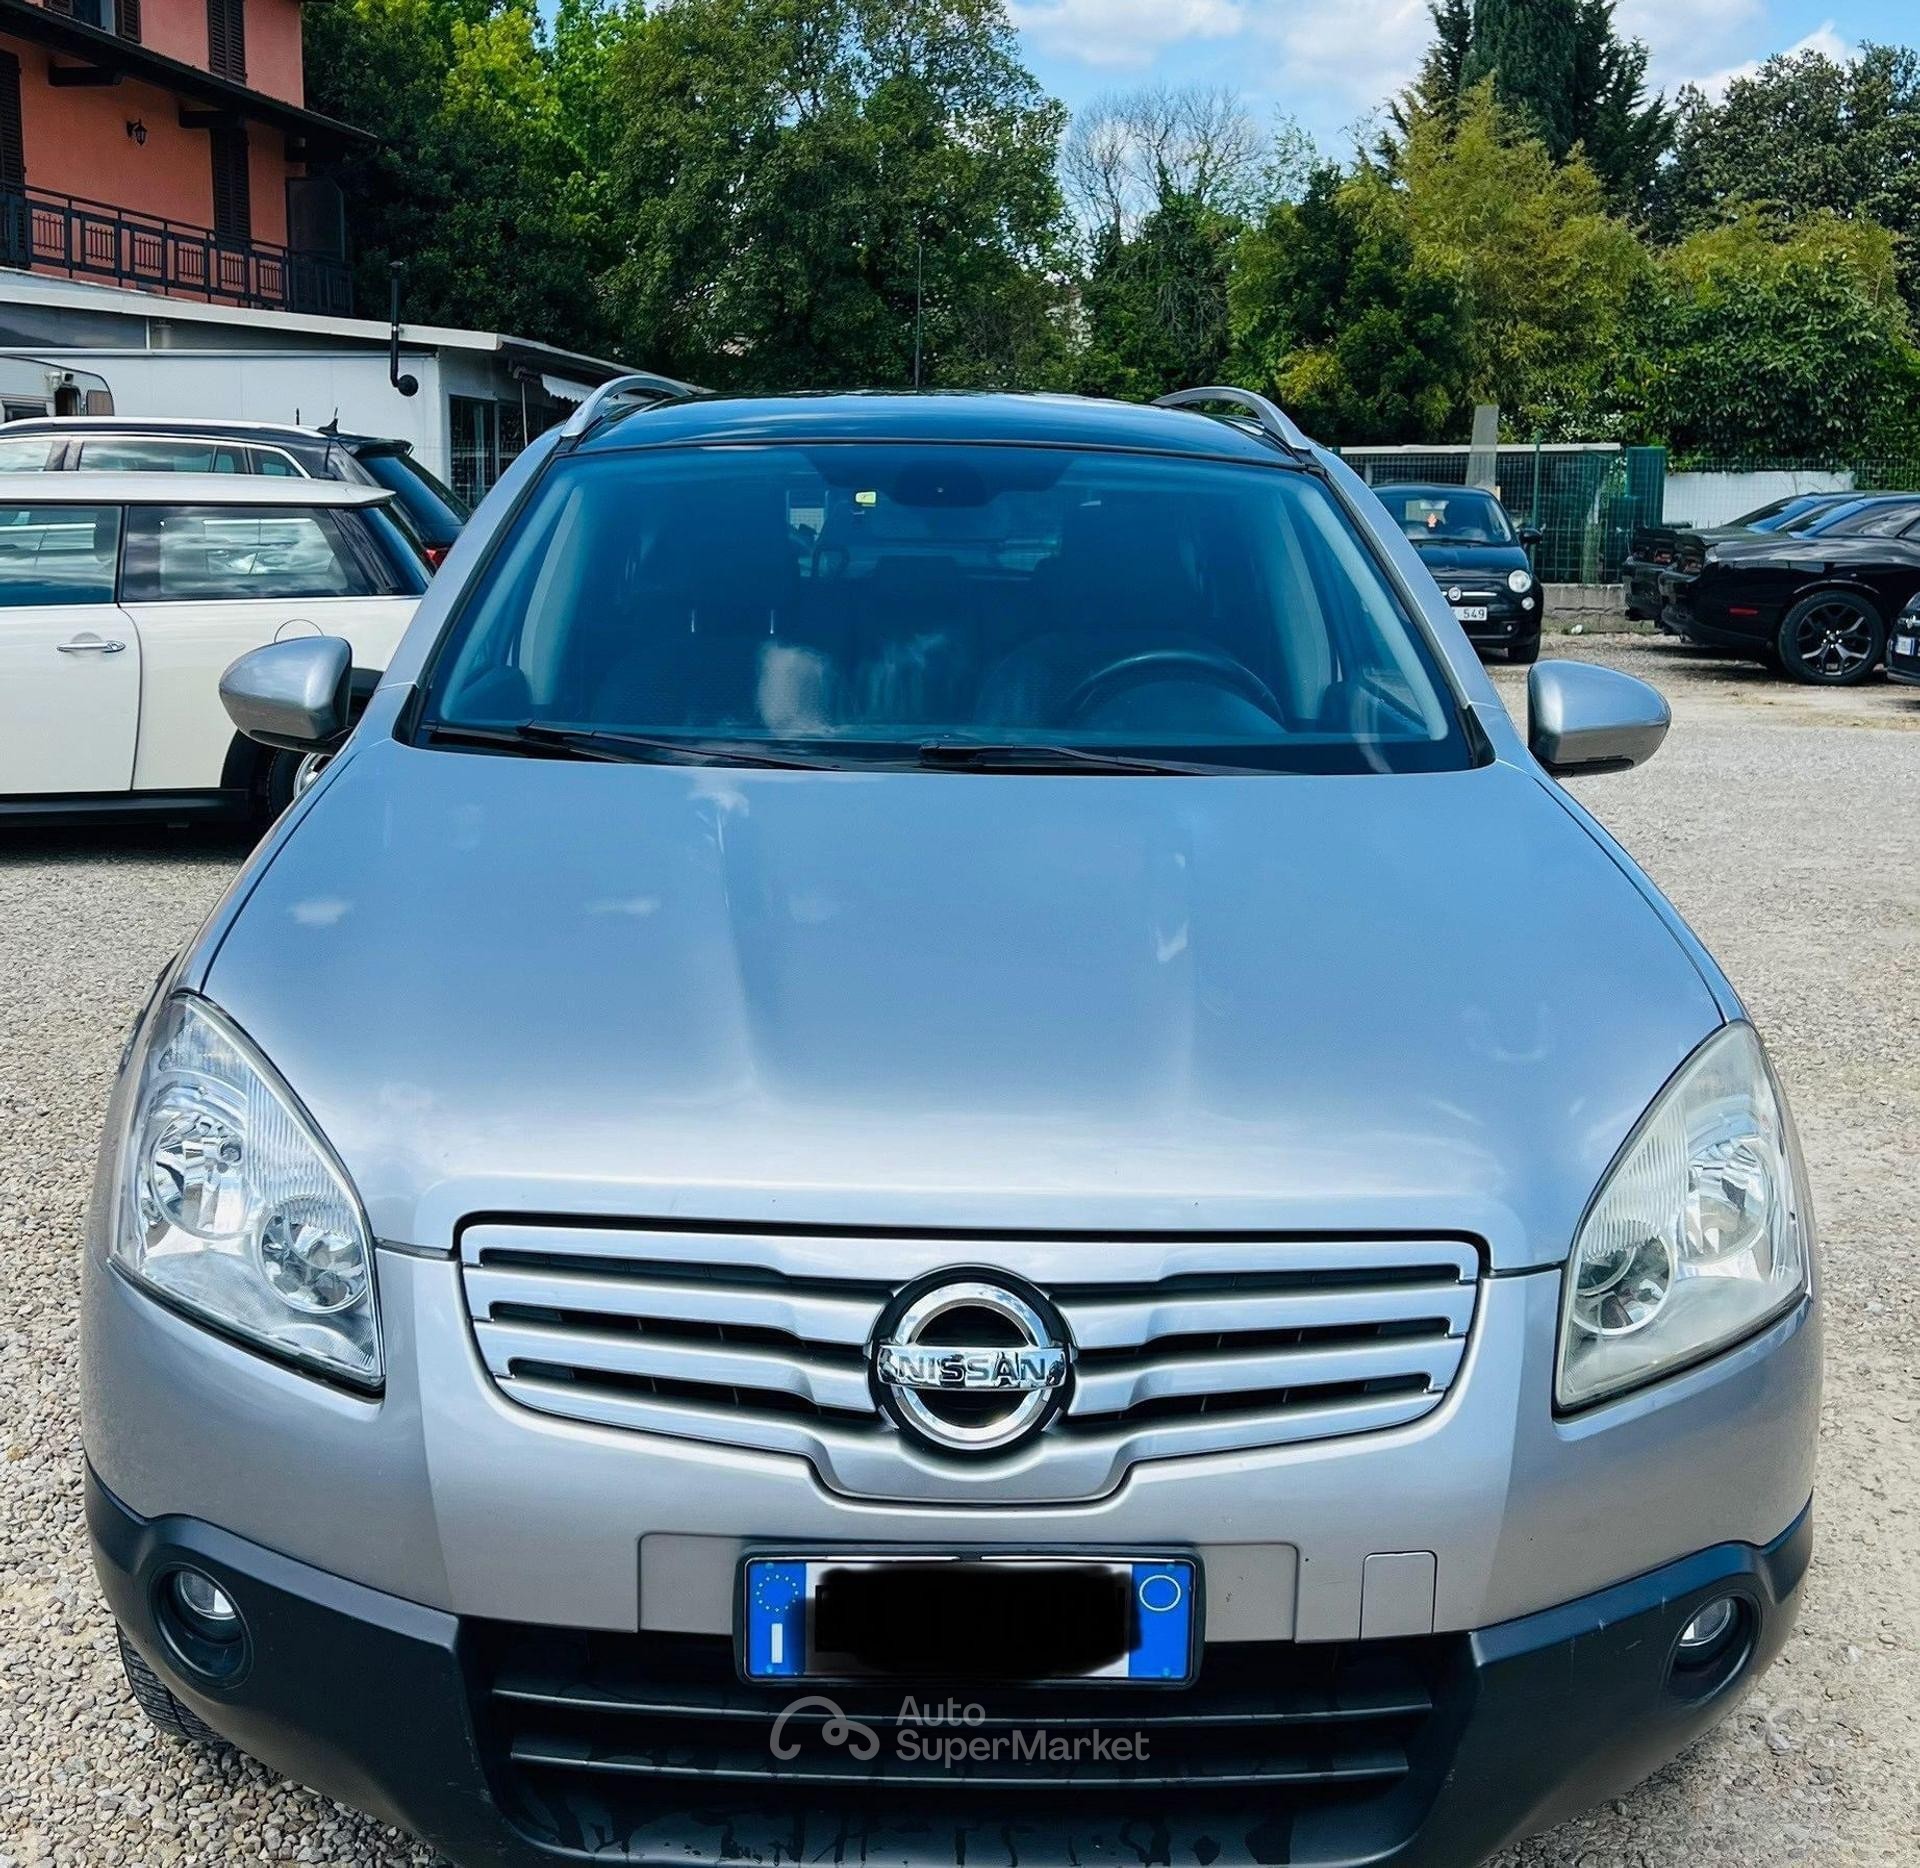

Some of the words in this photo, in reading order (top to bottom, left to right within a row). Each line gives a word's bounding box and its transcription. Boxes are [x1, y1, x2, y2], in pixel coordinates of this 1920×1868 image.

[1463, 609, 1485, 619] 549
[898, 1354, 1048, 1383] NISSAN
[771, 1623, 783, 1664] I
